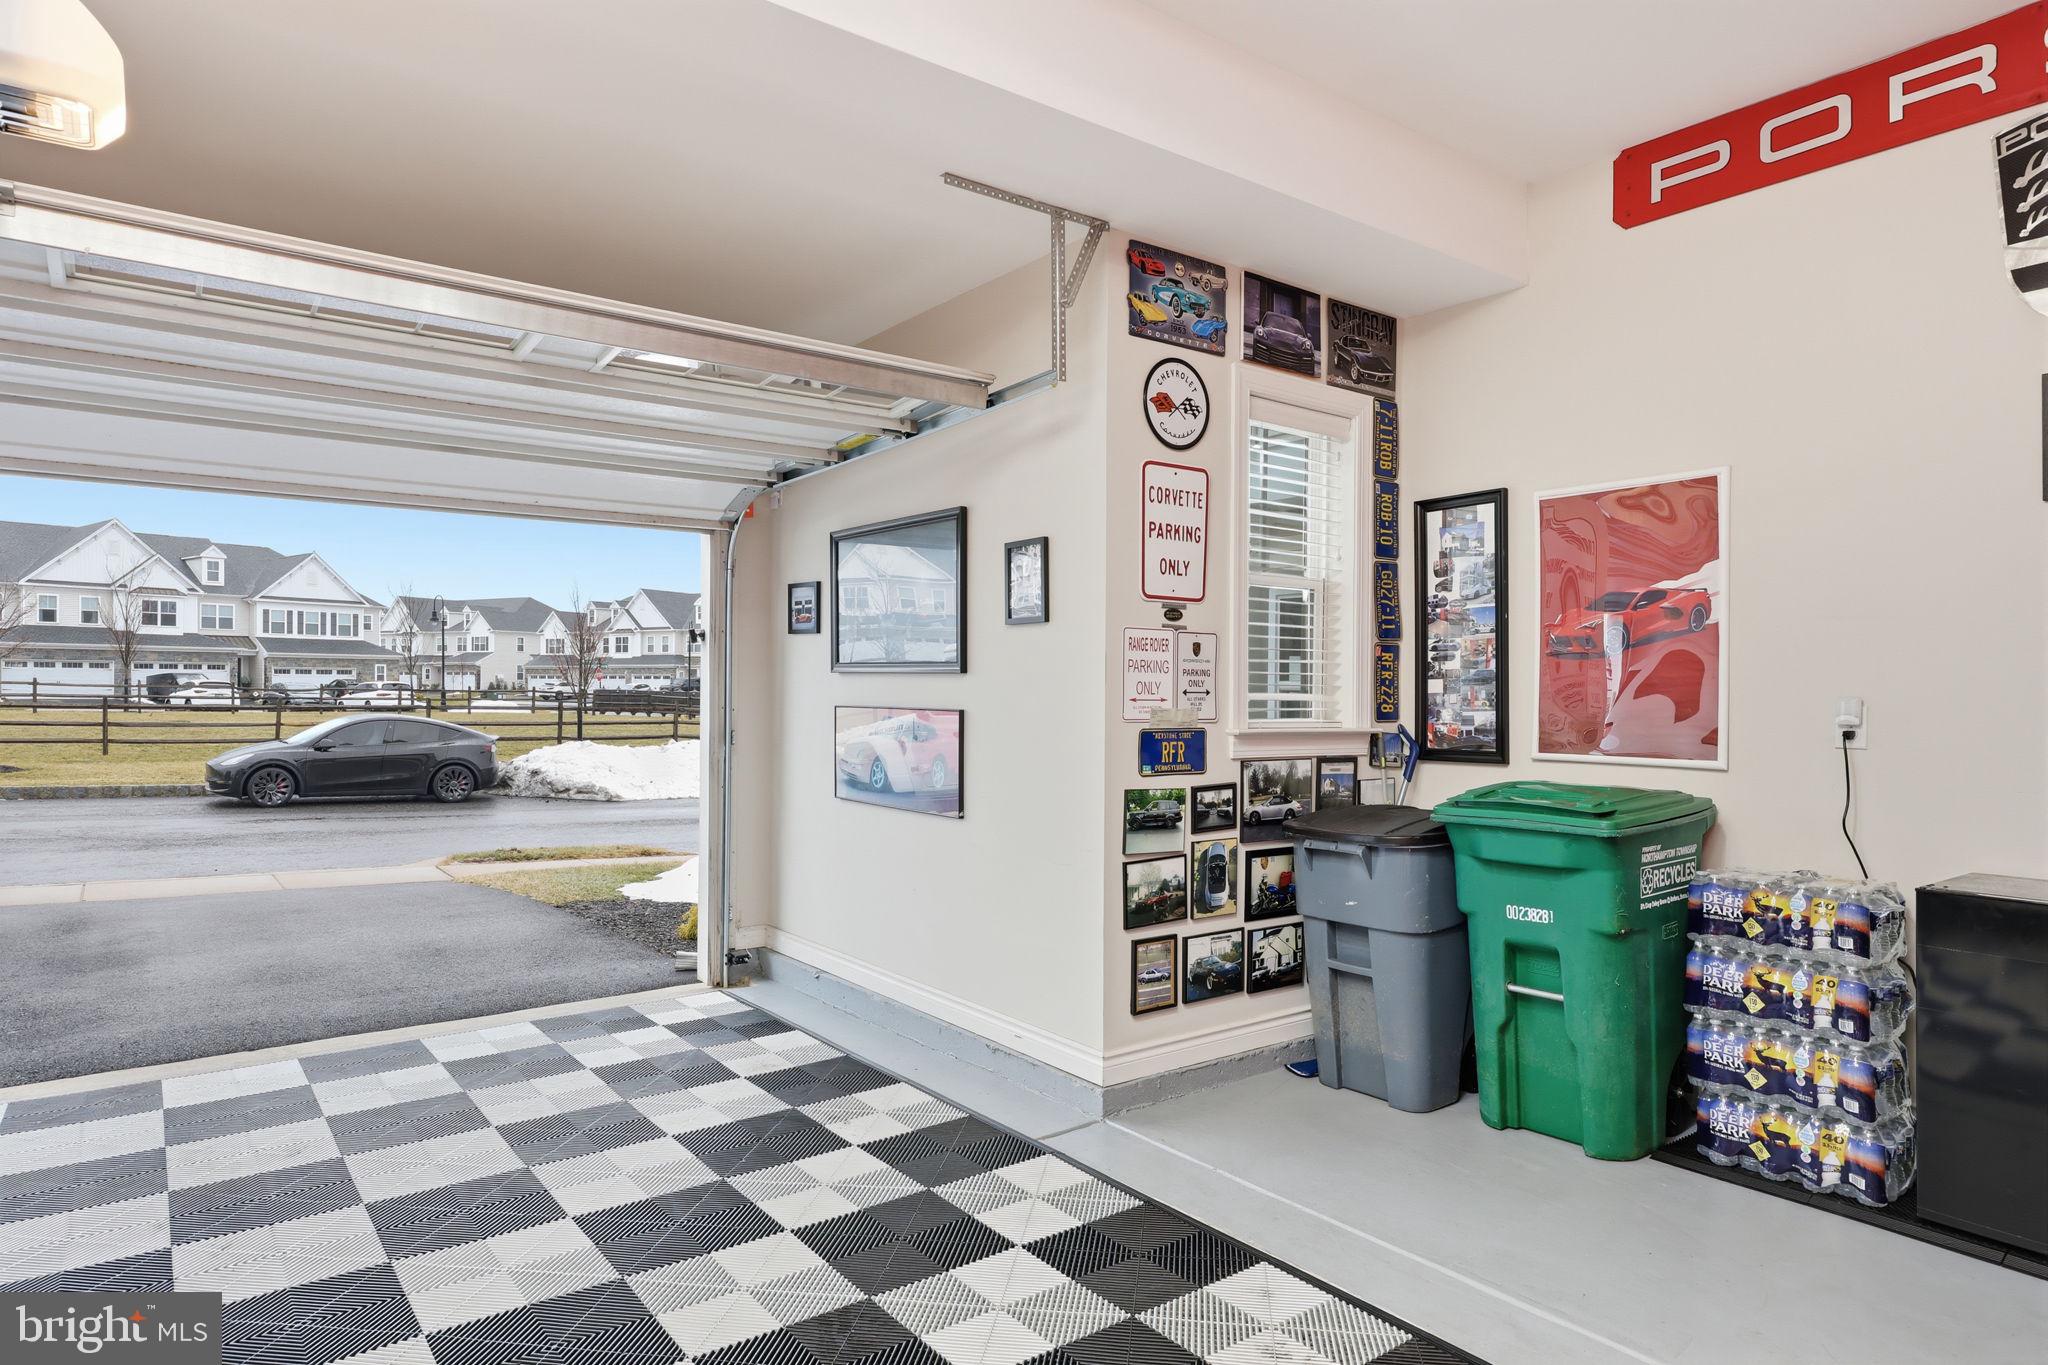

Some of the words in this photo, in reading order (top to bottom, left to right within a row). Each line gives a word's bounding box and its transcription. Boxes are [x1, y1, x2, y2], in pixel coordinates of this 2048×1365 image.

[1650, 28, 2048, 204] POR
[1331, 303, 1394, 345] STINGRAY
[1157, 369, 1197, 392] CHEVROLET
[1380, 409, 1393, 470] 7-11ROB
[1149, 486, 1203, 509] CORVETTE
[1380, 493, 1393, 545] ROB-10
[1149, 521, 1201, 543] PARKING
[1160, 558, 1190, 576] ONLY
[1128, 637, 1149, 652] RANGE
[1150, 638, 1170, 653] ROVER
[1127, 659, 1170, 674] PARKING
[1182, 669, 1211, 677] PARKING
[1136, 681, 1161, 695] ONLY
[1161, 741, 1185, 763] RFR
[1653, 862, 1696, 889] RECYCLES
[1703, 891, 1744, 908] DEER
[1703, 903, 1744, 919] PARK
[1703, 965, 1744, 982] DEER
[1703, 975, 1744, 993] PARK
[1703, 1040, 1744, 1057] DEER
[1704, 1050, 1745, 1069] PARK
[1710, 1108, 1750, 1128] DEER
[1710, 1120, 1750, 1139] PARK
[1823, 1133, 1844, 1144] 40
